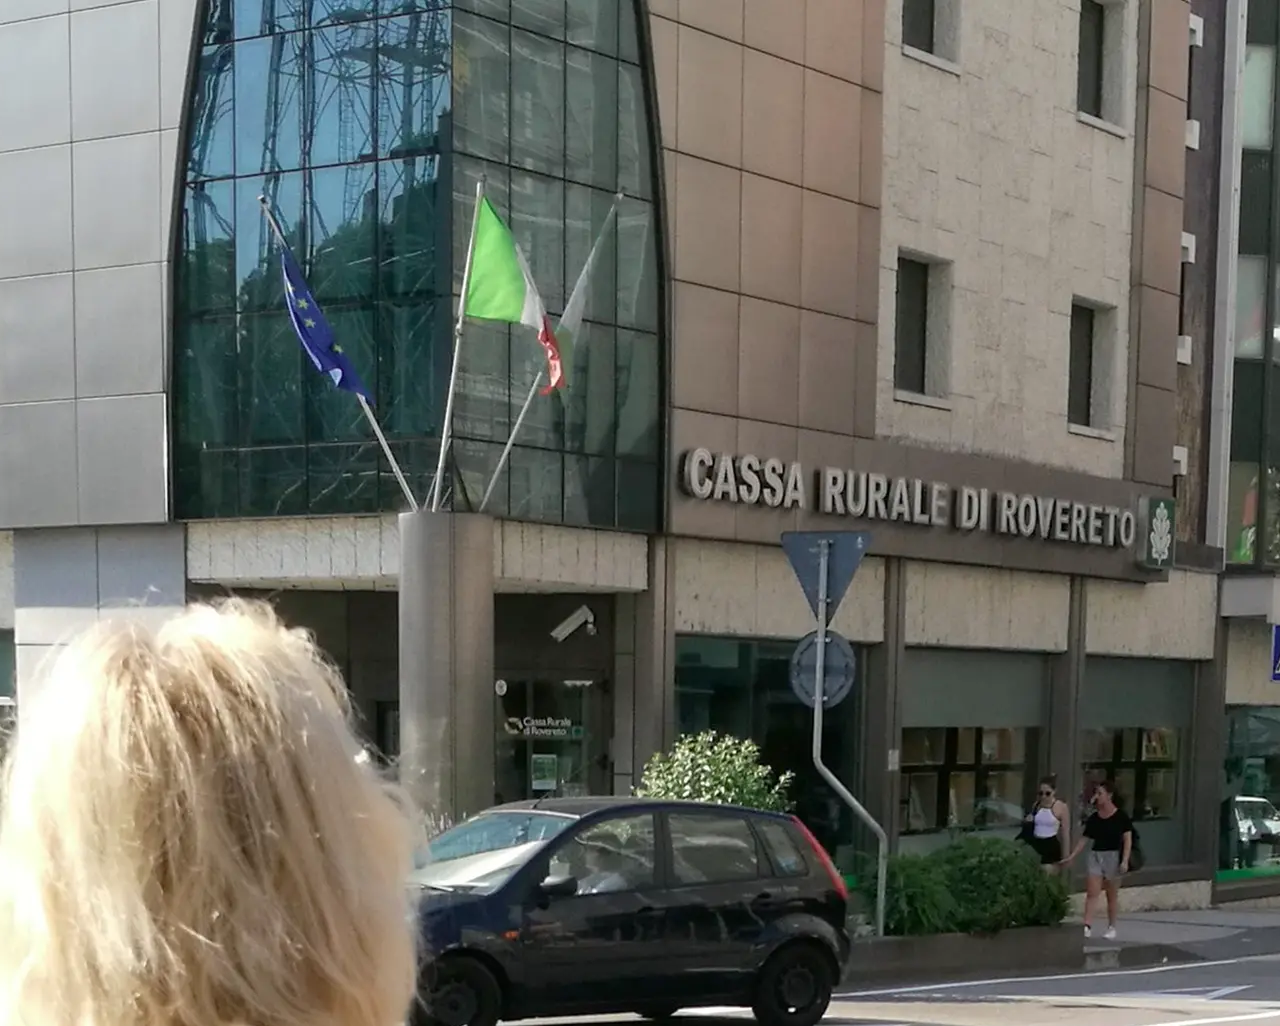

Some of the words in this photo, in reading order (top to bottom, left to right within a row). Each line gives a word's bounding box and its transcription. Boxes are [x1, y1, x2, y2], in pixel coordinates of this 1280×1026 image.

[686, 446, 807, 510] CASSA
[823, 464, 949, 526] RURALE
[959, 485, 989, 531] DI
[998, 491, 1137, 548] ROVERETO
